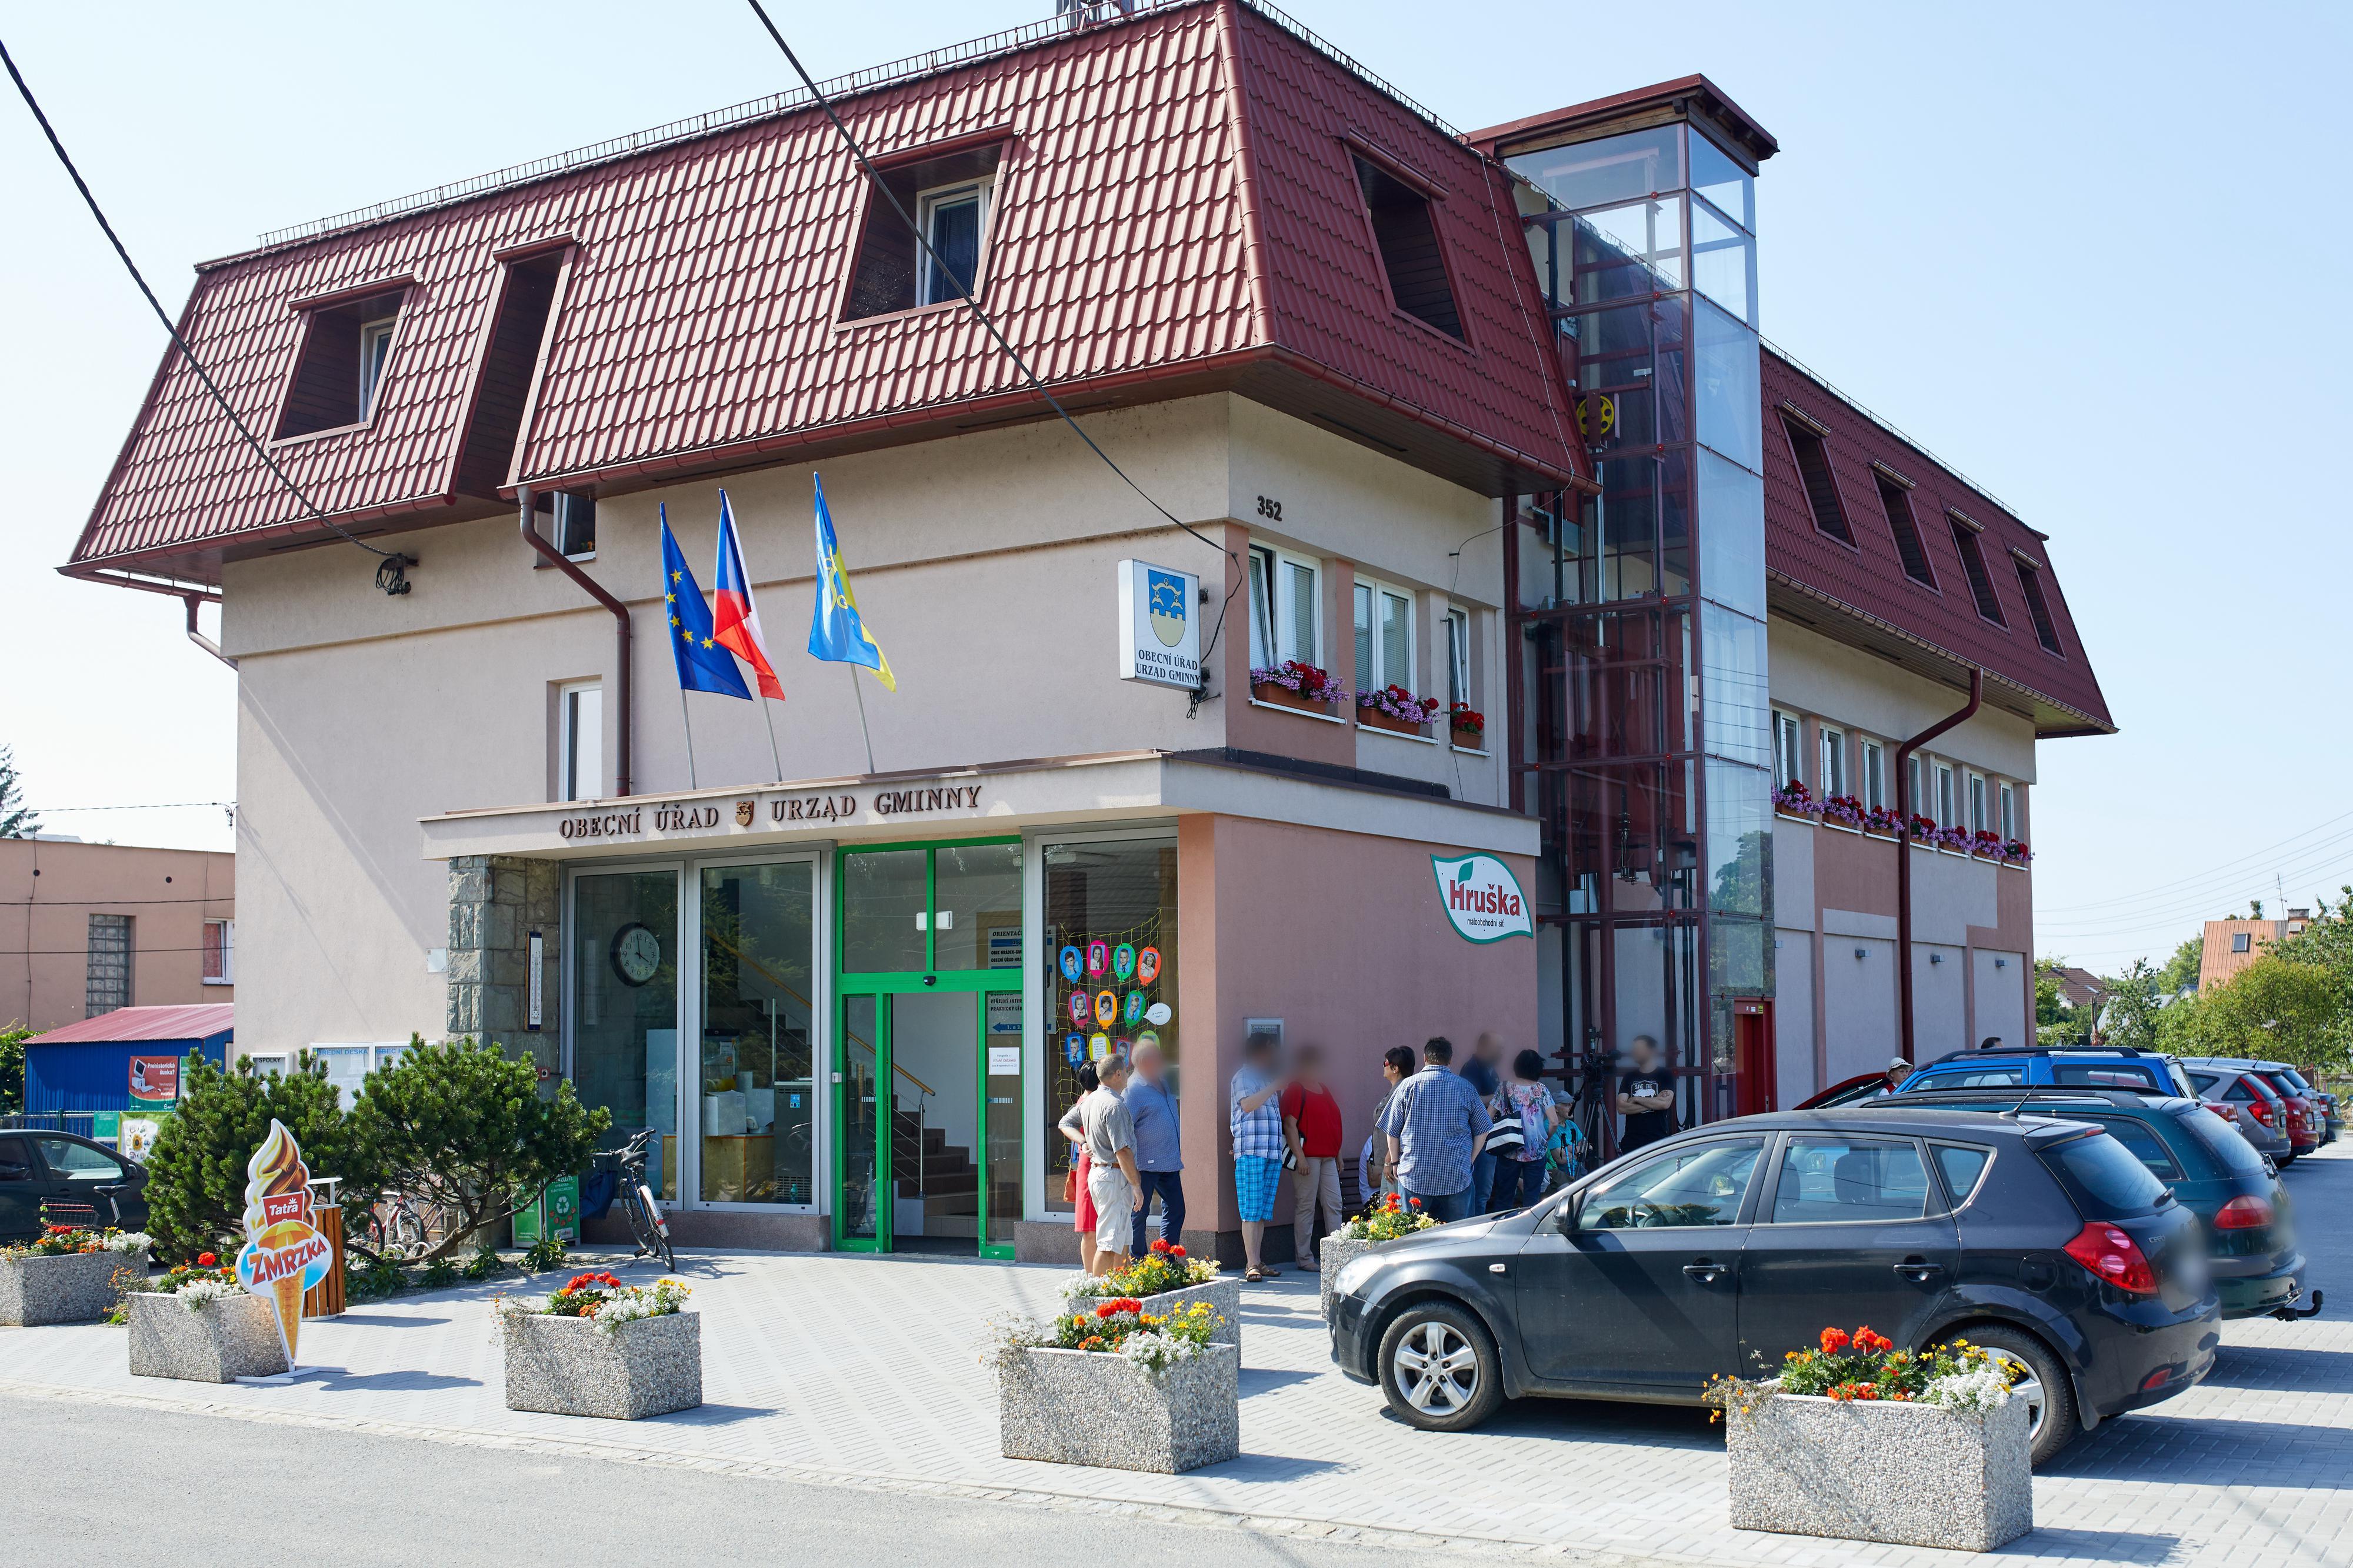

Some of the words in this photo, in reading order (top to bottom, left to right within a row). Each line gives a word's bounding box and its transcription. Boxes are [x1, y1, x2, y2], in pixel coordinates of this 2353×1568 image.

[1257, 495, 1282, 522] 352
[1138, 649, 1171, 665] OBECNÍ
[1174, 654, 1198, 670] ÚŘAD
[1136, 663, 1165, 679] URZĄD
[1169, 670, 1201, 685] GMINNY
[559, 807, 641, 839] OBECNÍ
[654, 803, 719, 831] ÚŘAD
[770, 795, 856, 822] URZĄD
[874, 786, 981, 815] GMINNY
[1450, 879, 1521, 916] Hruška
[992, 929, 1022, 937] ORIENTAČ
[269, 1203, 298, 1216] Tatra
[249, 1237, 328, 1286] ZMRZKA
